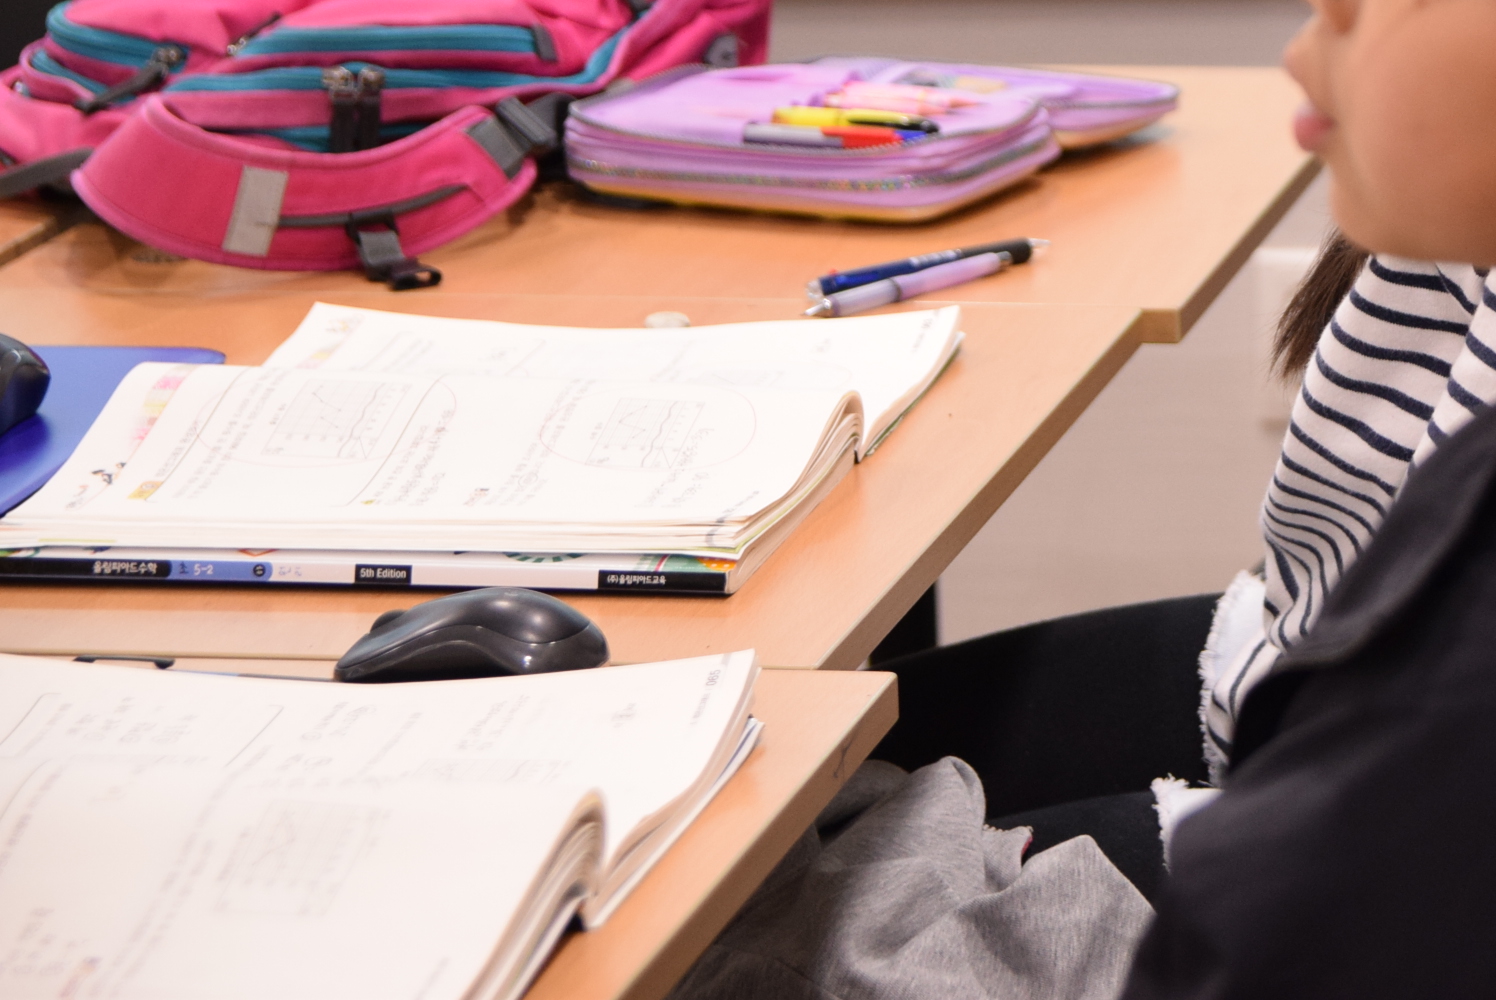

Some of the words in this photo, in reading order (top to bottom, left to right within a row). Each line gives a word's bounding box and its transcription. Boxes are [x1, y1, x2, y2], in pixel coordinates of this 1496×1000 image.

[93, 560, 158, 574] 올림피아드수학
[194, 563, 214, 576] 5-2
[360, 567, 375, 578] 5th
[376, 568, 407, 579] Edition
